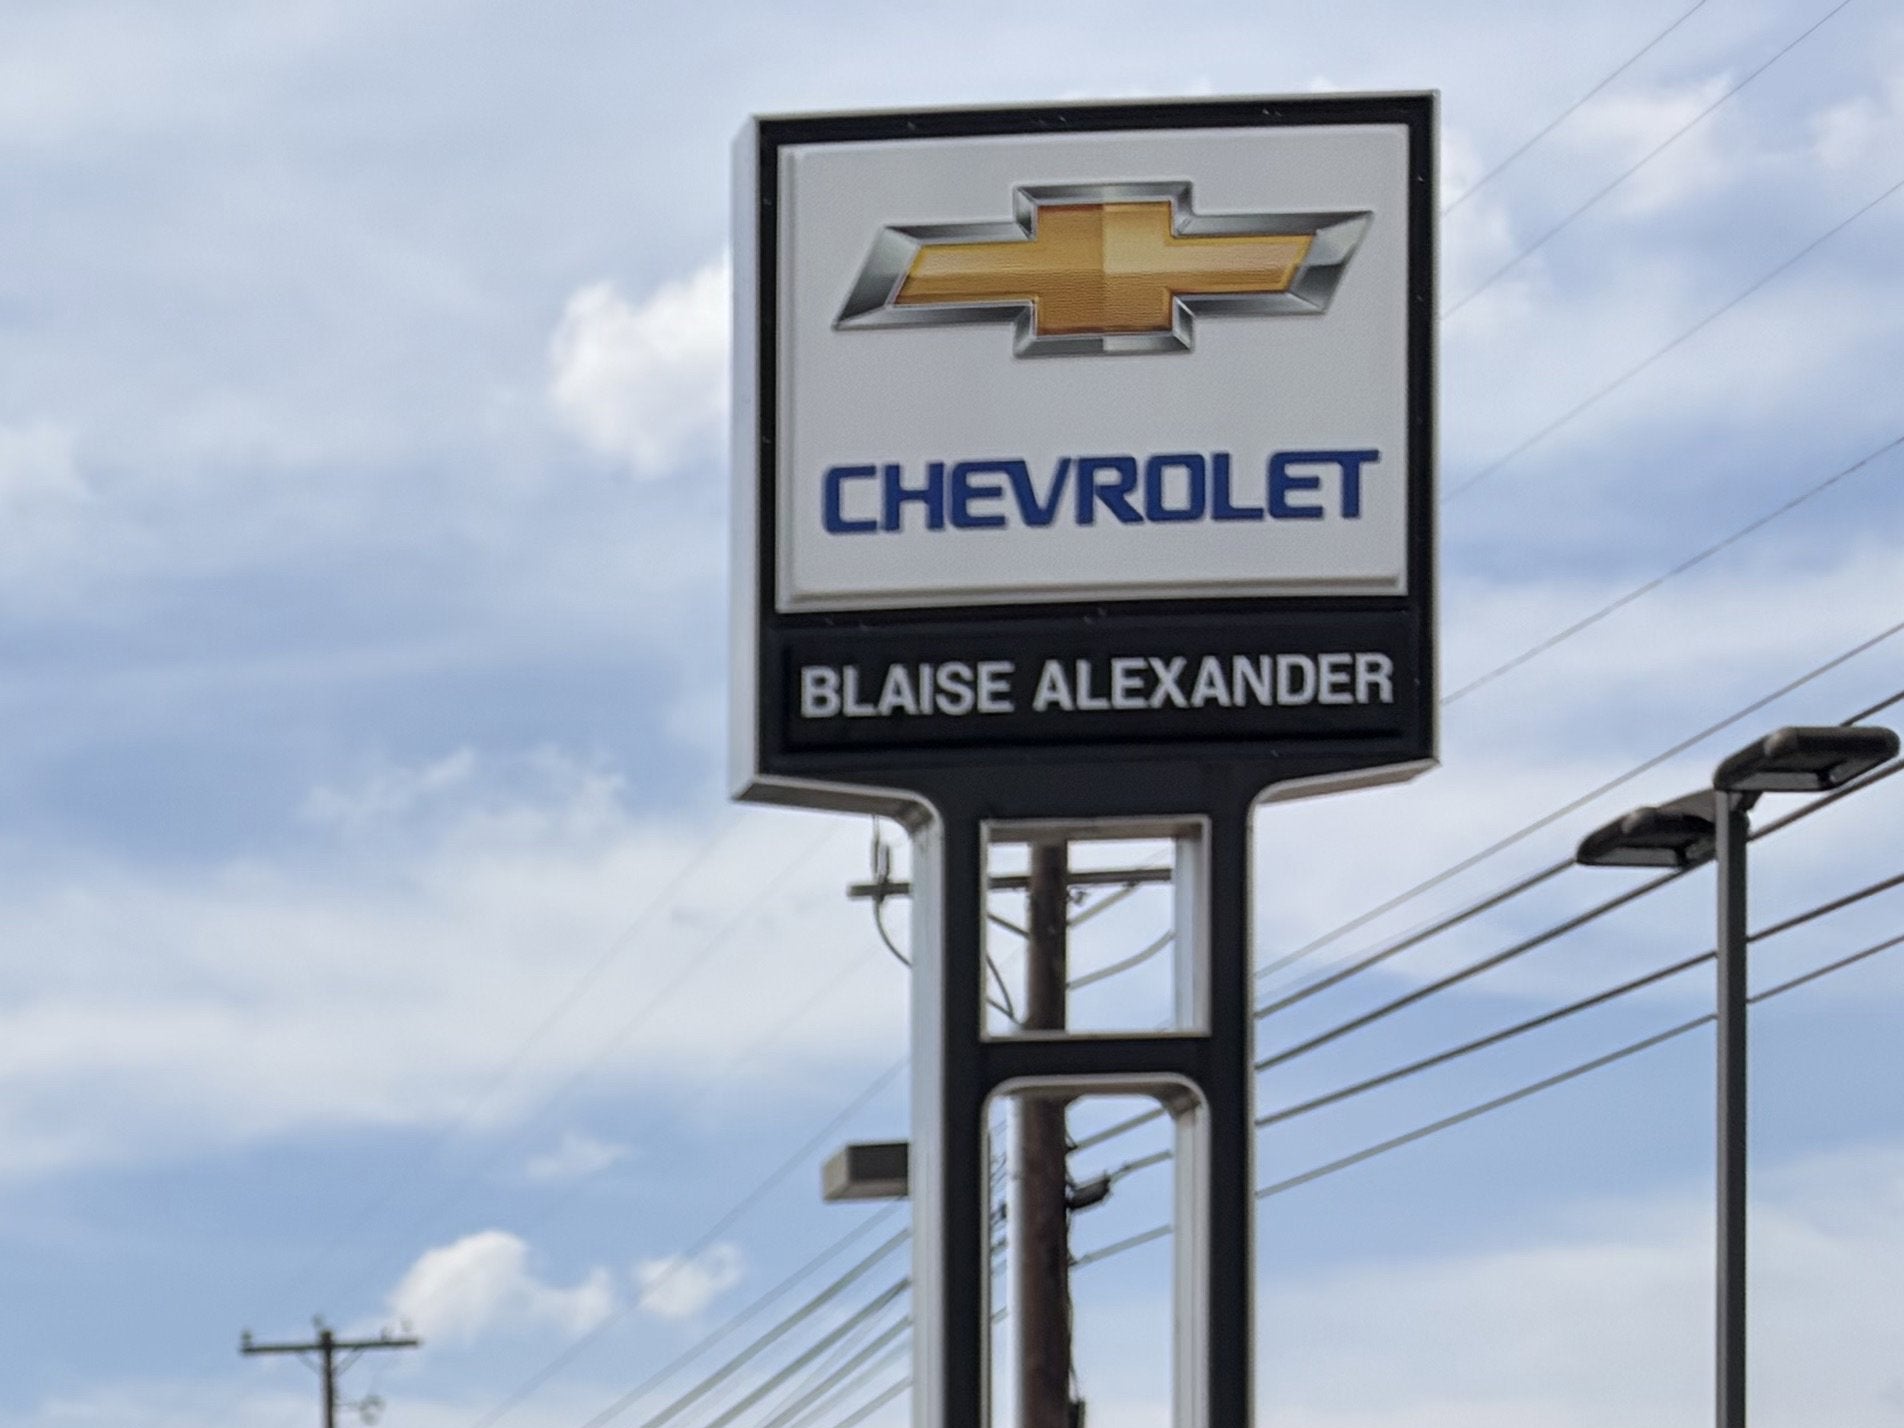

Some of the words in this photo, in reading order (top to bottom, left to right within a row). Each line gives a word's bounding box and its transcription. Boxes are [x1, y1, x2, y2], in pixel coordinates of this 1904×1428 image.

[822, 449, 1380, 535] CHEVROLET
[800, 660, 1015, 718] BLAISE
[1034, 652, 1394, 710] ALEXANDER
